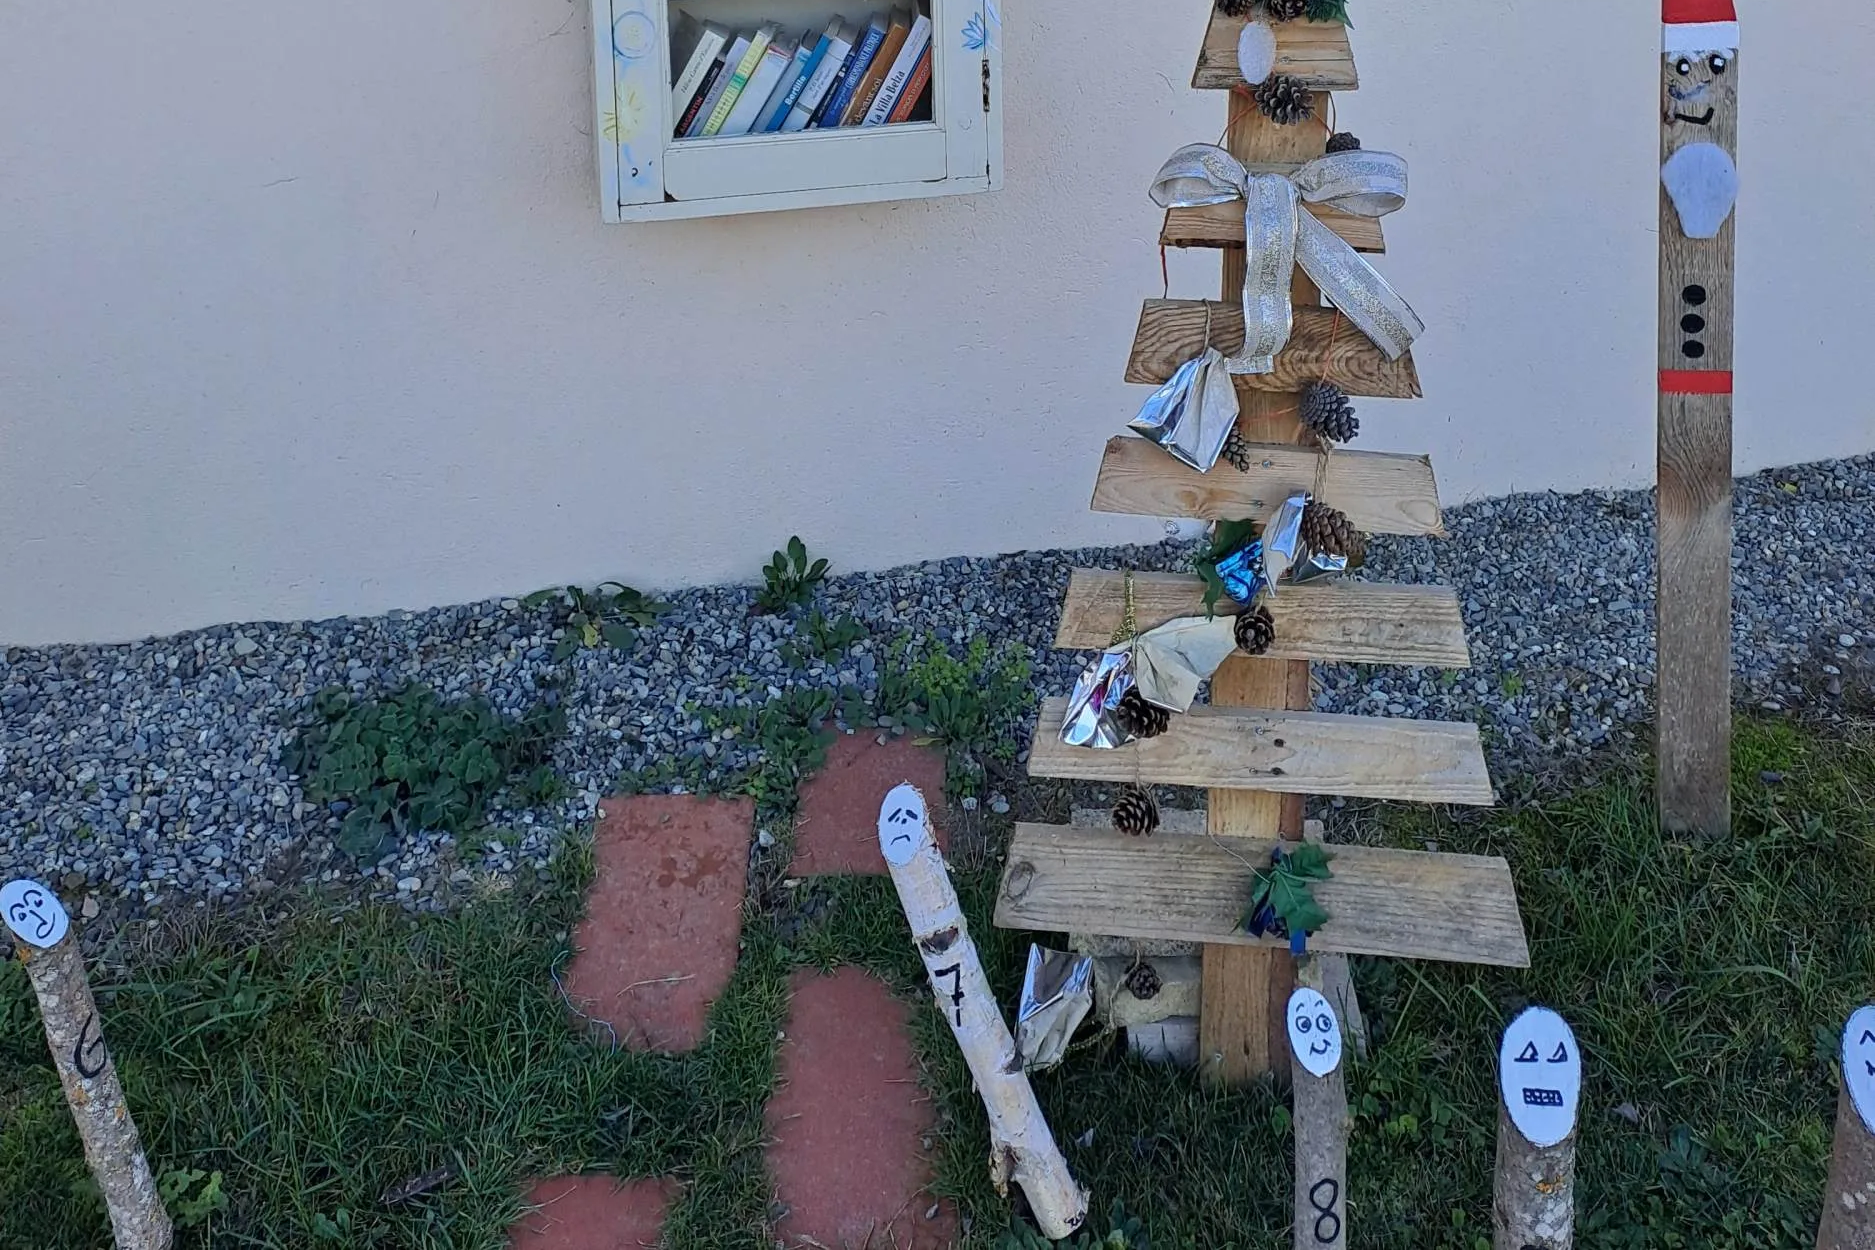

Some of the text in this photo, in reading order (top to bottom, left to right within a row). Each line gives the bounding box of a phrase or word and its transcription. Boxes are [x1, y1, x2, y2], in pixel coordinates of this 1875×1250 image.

[869, 70, 905, 125] La Villa Belza
[934, 963, 965, 1027] 7
[73, 1011, 106, 1078] 6
[1309, 1178, 1340, 1243] 8
